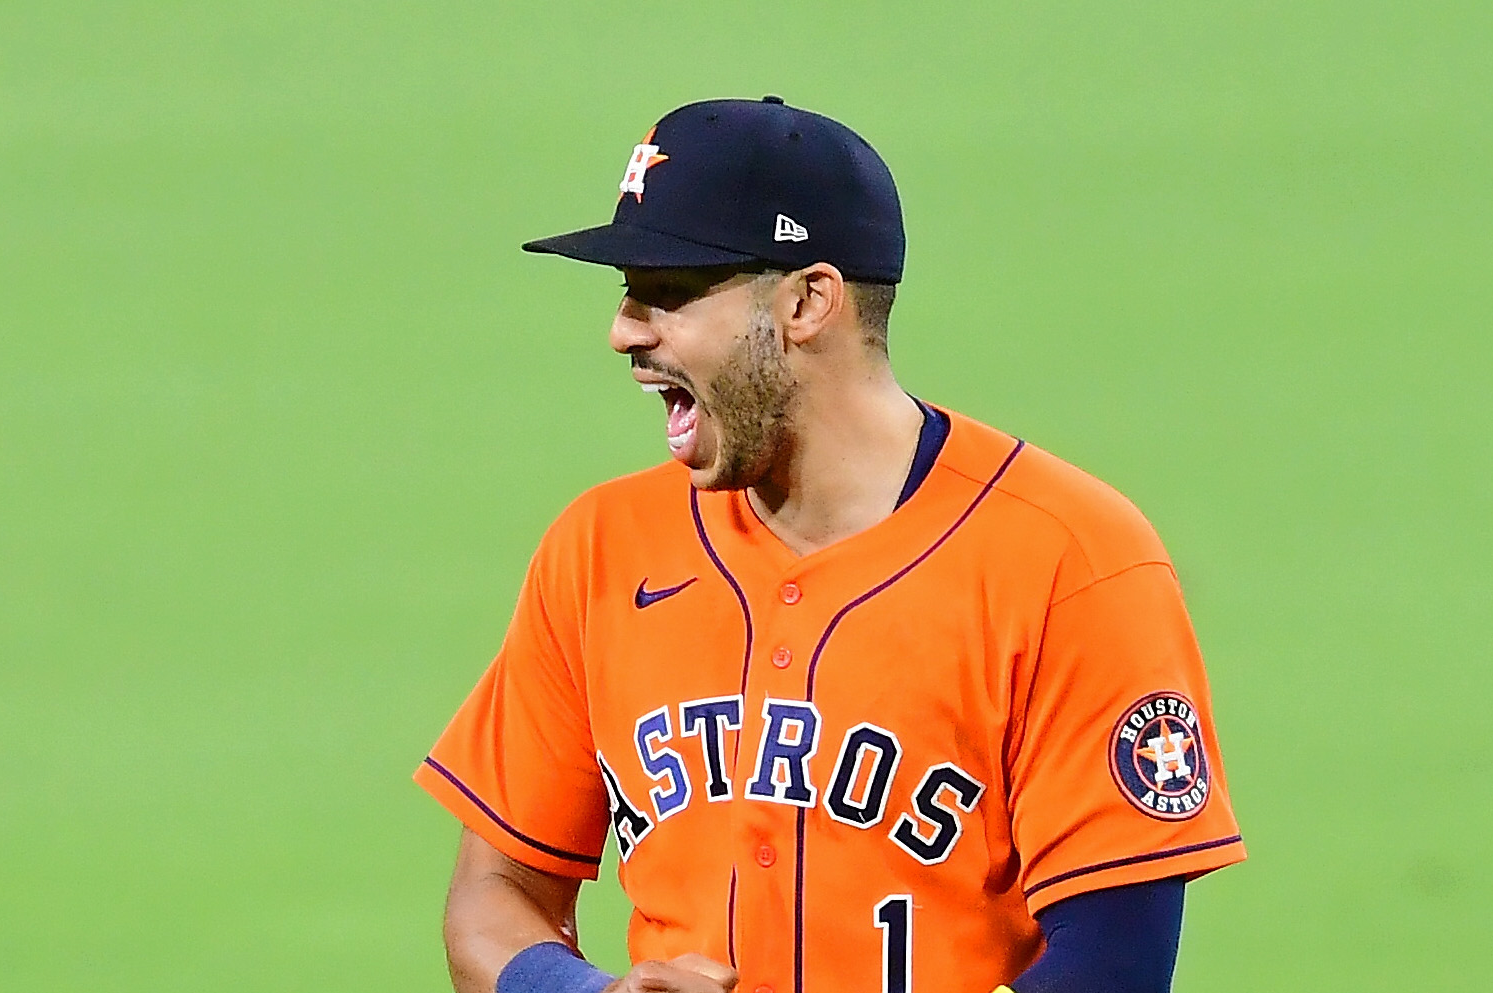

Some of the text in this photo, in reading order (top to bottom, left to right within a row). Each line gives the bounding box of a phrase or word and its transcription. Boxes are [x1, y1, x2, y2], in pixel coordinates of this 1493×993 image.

[619, 143, 660, 194] H
[1120, 699, 1197, 743] HOUSTON
[1147, 732, 1191, 782] H
[1140, 778, 1207, 813] ASTROS
